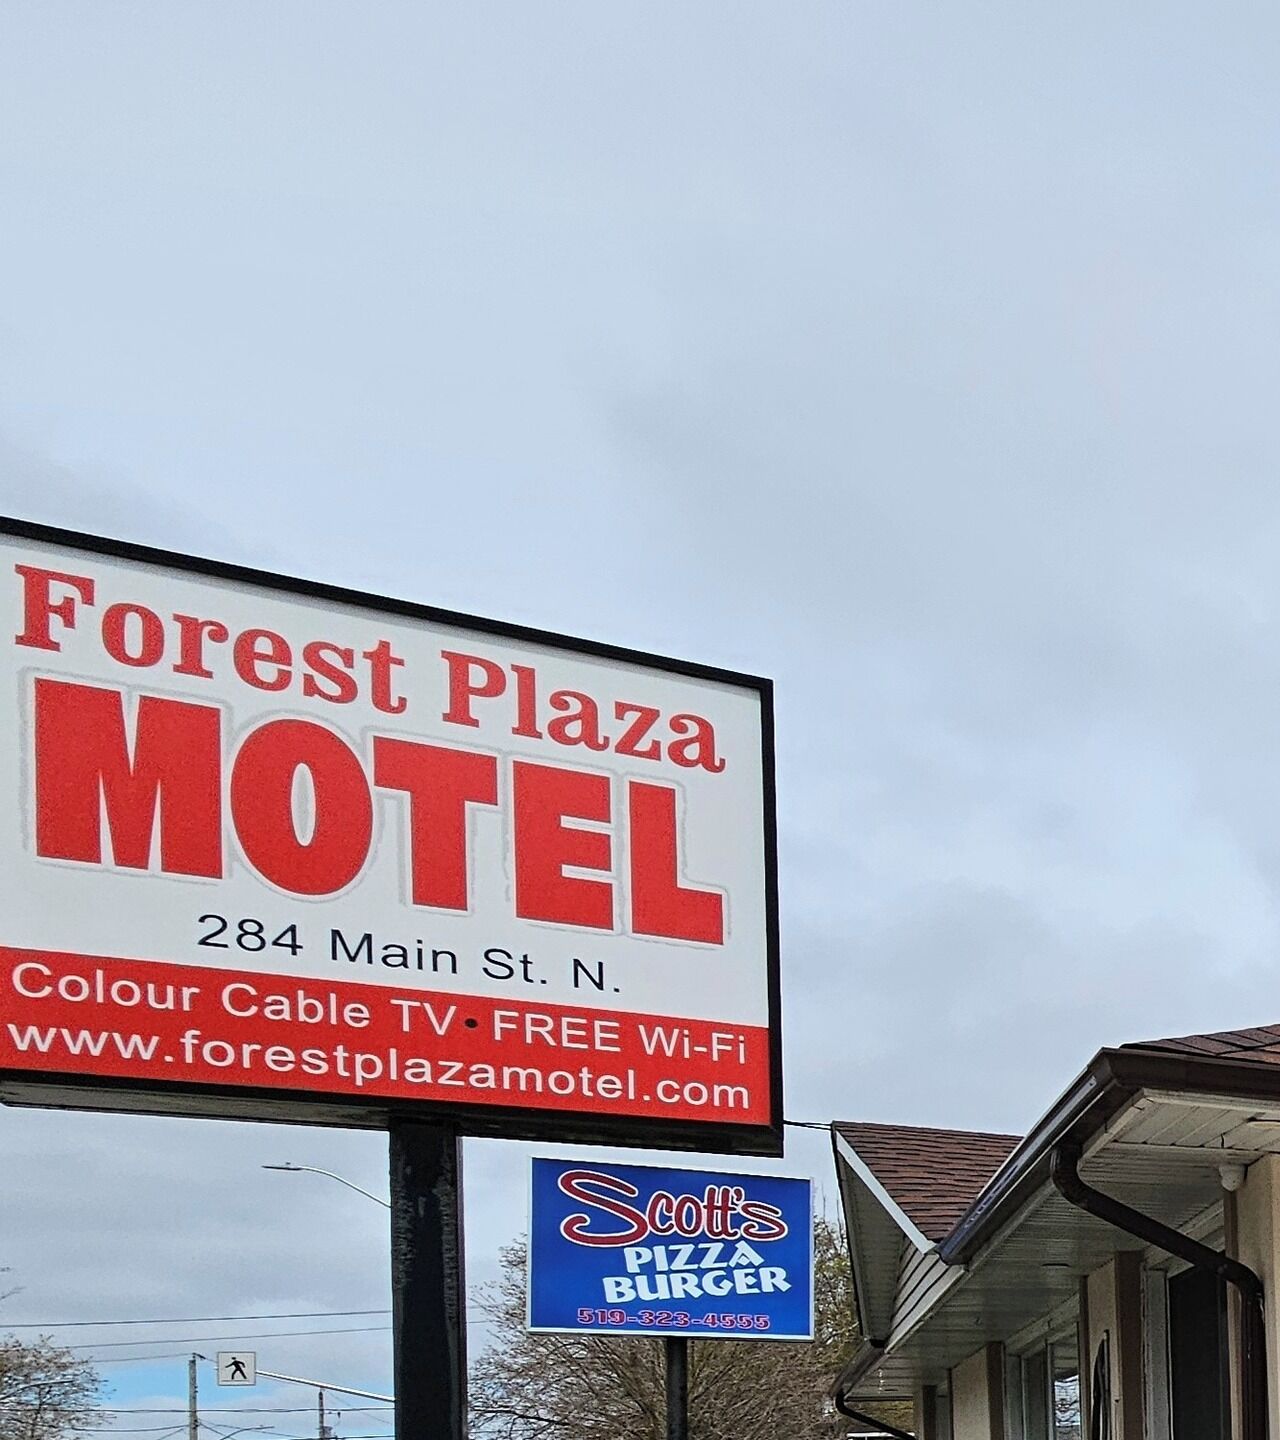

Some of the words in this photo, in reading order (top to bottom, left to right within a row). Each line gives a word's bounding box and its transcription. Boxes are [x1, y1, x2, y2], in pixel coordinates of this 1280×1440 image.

[13, 563, 408, 716] Forest
[440, 649, 726, 773] Plaza
[34, 677, 725, 946] MOTEL
[197, 913, 304, 957] 284
[330, 928, 458, 975] Main
[482, 947, 547, 985] St.
[572, 957, 621, 993] N.
[11, 961, 201, 1012] Colour
[221, 982, 371, 1028] Cable
[390, 998, 457, 1036] TV
[492, 1008, 622, 1053] FREE
[638, 1023, 746, 1065] Wi-Fi
[6, 1022, 750, 1109] www.forestplazamotel.com
[558, 1169, 788, 1247] Scott's
[602, 1266, 792, 1304] BURGER
[623, 1240, 765, 1274] PIZZA
[577, 1307, 771, 1331] 519-323-4555
